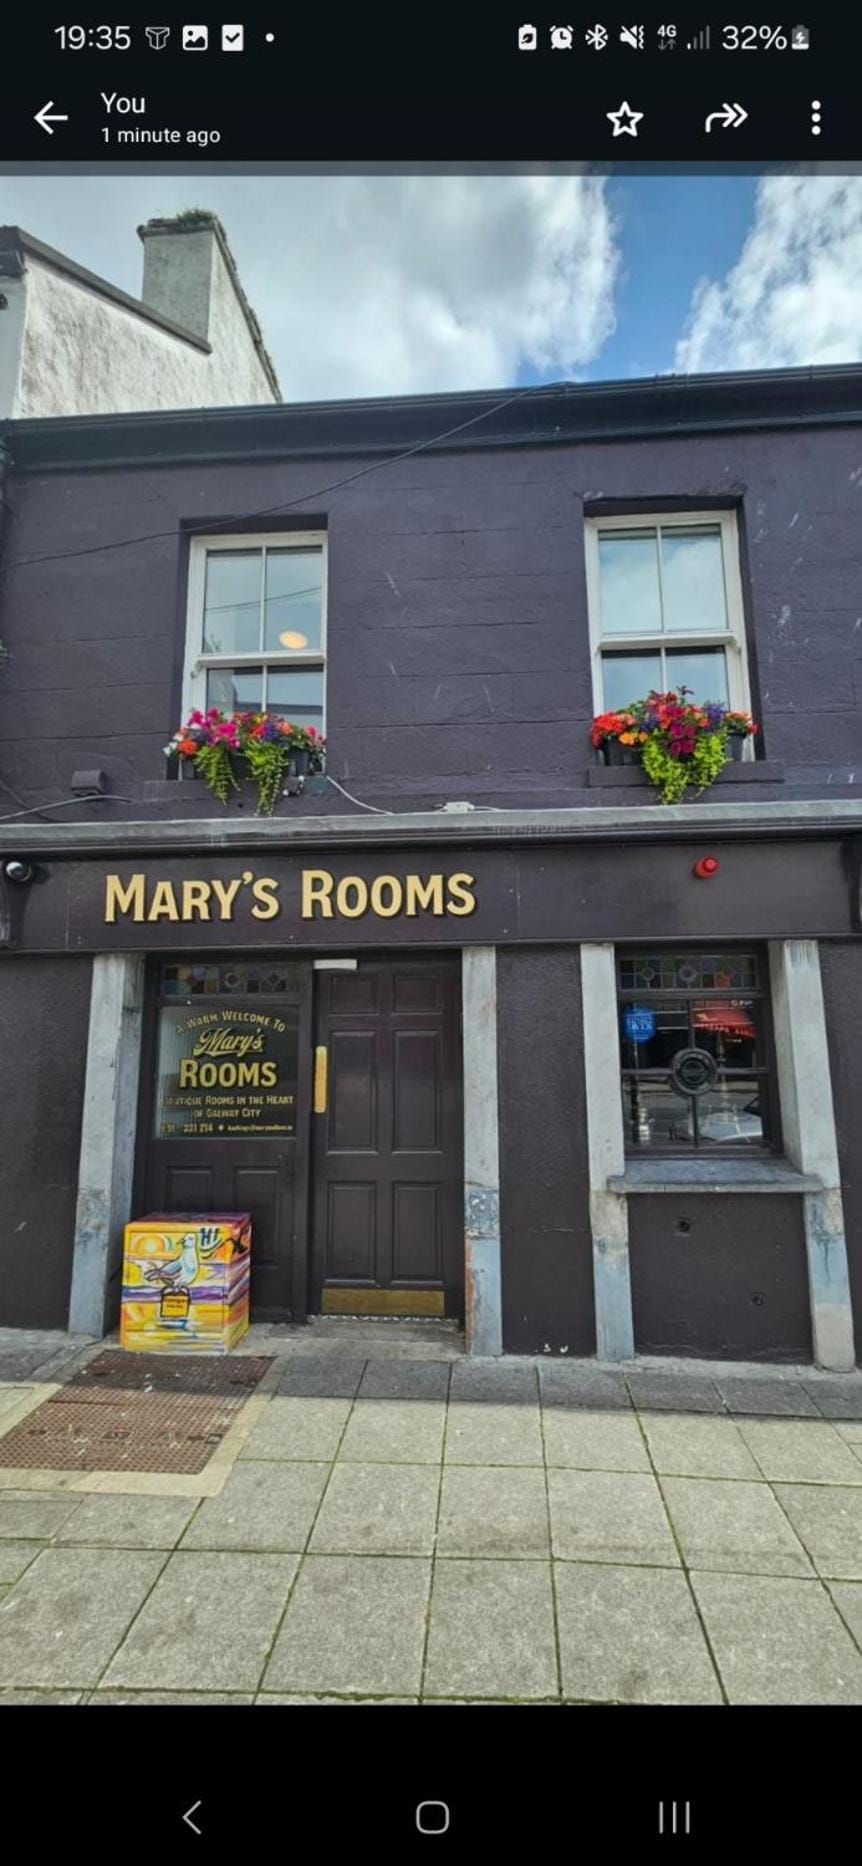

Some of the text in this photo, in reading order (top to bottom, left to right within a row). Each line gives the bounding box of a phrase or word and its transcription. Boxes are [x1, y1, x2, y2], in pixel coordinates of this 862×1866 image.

[105, 869, 476, 922] MARY'S ROOMS
[186, 1013, 218, 1029] WARM
[222, 1010, 270, 1026] WELCOME
[273, 1019, 286, 1033] TO
[193, 1027, 265, 1057] Mary's
[179, 1059, 278, 1089] ROOMS
